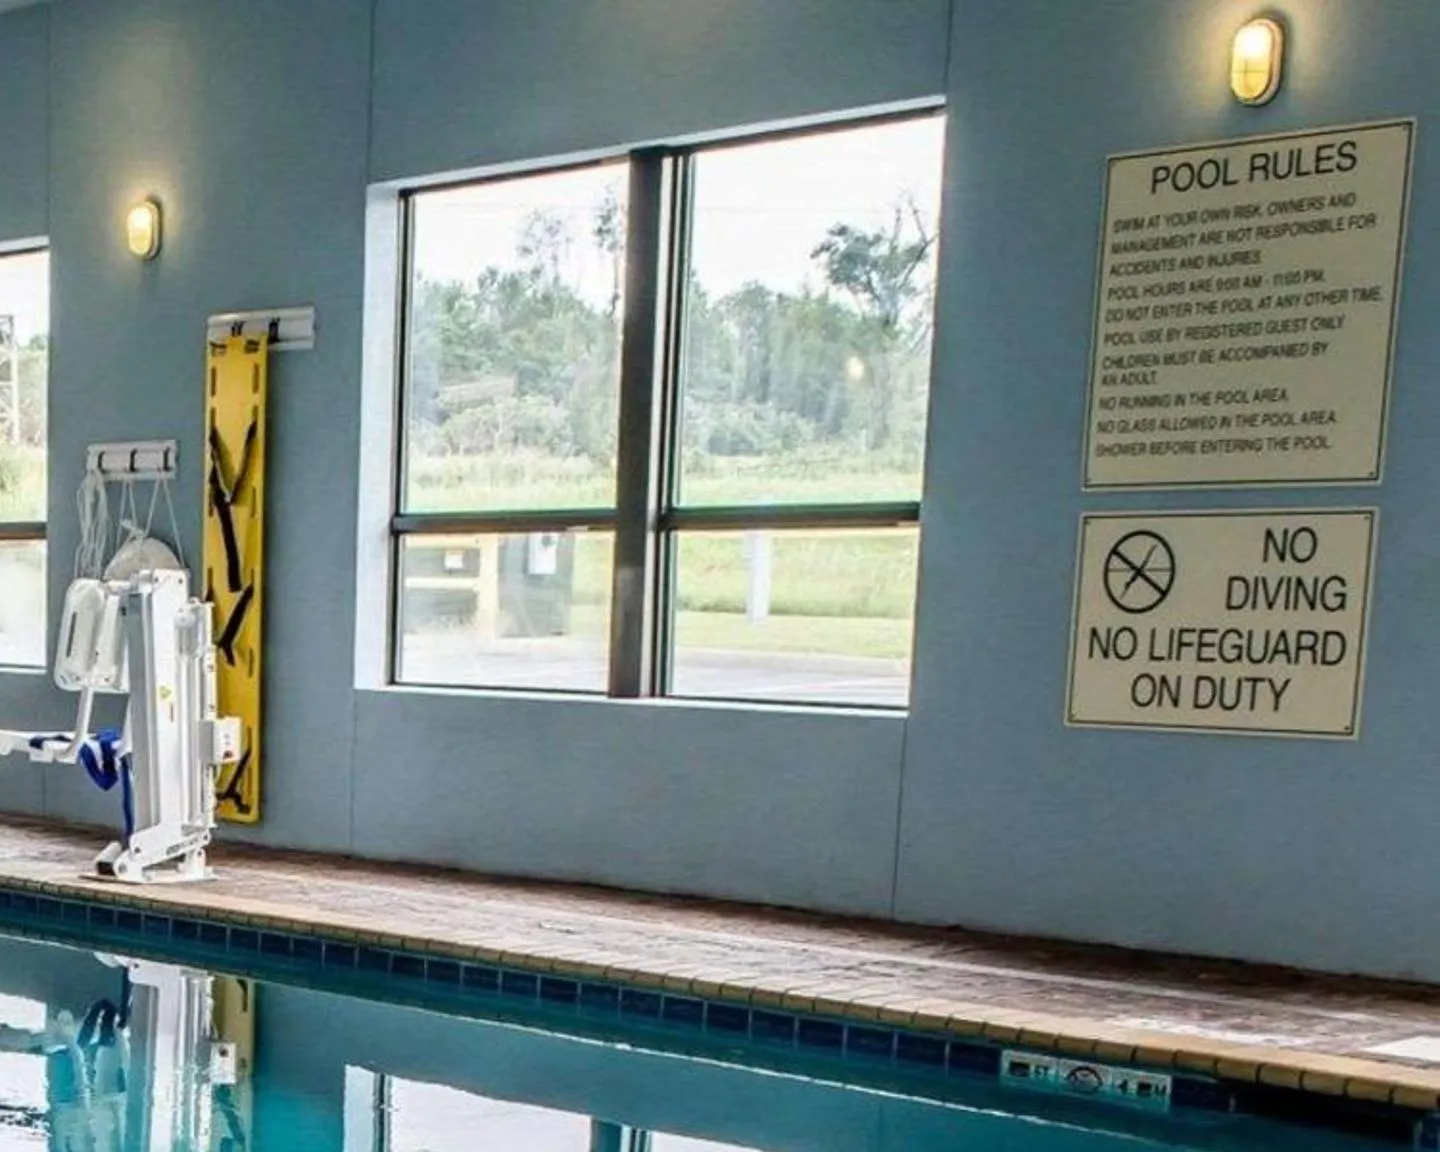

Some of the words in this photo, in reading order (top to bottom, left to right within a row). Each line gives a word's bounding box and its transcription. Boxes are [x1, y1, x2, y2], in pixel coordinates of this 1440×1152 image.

[1151, 158, 1238, 194] POOL
[1248, 140, 1357, 181] RULES
[1113, 217, 1144, 233] SWIM
[1146, 214, 1160, 228] AT
[1163, 210, 1197, 227] YOUR
[1200, 207, 1230, 223] OWN
[1267, 196, 1325, 215] OWNERS
[1328, 192, 1356, 207] AND
[1111, 233, 1197, 254] MANAGEMENT
[1199, 229, 1223, 244] ARE
[1226, 227, 1252, 242] NOT
[1256, 216, 1345, 240] RESPONSIBLE
[1347, 212, 1377, 229] FOR
[1110, 257, 1176, 276] ACCIDENTS
[1179, 254, 1204, 270] AND
[1107, 284, 1139, 301] POOL
[1142, 281, 1185, 297] HOURS
[1188, 277, 1213, 292] ARE
[1243, 274, 1262, 288] AM
[1105, 308, 1123, 323] DO
[1125, 305, 1149, 321] NOT
[1151, 301, 1193, 319] ENTER
[1195, 300, 1218, 315] THE
[1221, 297, 1253, 314] POOL
[1258, 295, 1272, 309] AT
[1275, 293, 1301, 308] ANY
[1304, 288, 1349, 307] OTHER
[1103, 331, 1136, 346] POOL
[1139, 328, 1163, 344] USE
[1166, 327, 1183, 343] BY
[1184, 321, 1262, 341] REGISTERED
[1265, 317, 1308, 335] GUEST
[1102, 353, 1160, 370] CHILDREN
[1163, 350, 1196, 366] MUST
[1198, 348, 1215, 364] BE
[1218, 342, 1309, 363] ACCOMPANIED
[1311, 341, 1329, 357] BY
[1101, 371, 1118, 386] AN
[1099, 396, 1116, 410] NO
[1118, 393, 1171, 410] RUNNING
[1174, 393, 1186, 407] IN
[1189, 390, 1213, 406] THE
[1215, 389, 1249, 405] POOL
[1097, 419, 1114, 434] NO
[1117, 417, 1156, 434] GLASS
[1158, 415, 1217, 432] ALLOWED
[1219, 416, 1232, 429] IN
[1235, 413, 1260, 428] THE
[1261, 411, 1296, 427] POOL
[1096, 441, 1146, 457] SHOWER
[1148, 440, 1196, 456] BEFORE
[1200, 438, 1262, 455] ENTERING
[1264, 436, 1291, 451] THE
[1263, 526, 1318, 563] NO
[1225, 575, 1347, 612] DIVING
[1088, 626, 1138, 661] NO
[1149, 628, 1347, 666] LIFEGUARD
[1131, 673, 1181, 708] ON
[1192, 675, 1291, 712] DUTY
